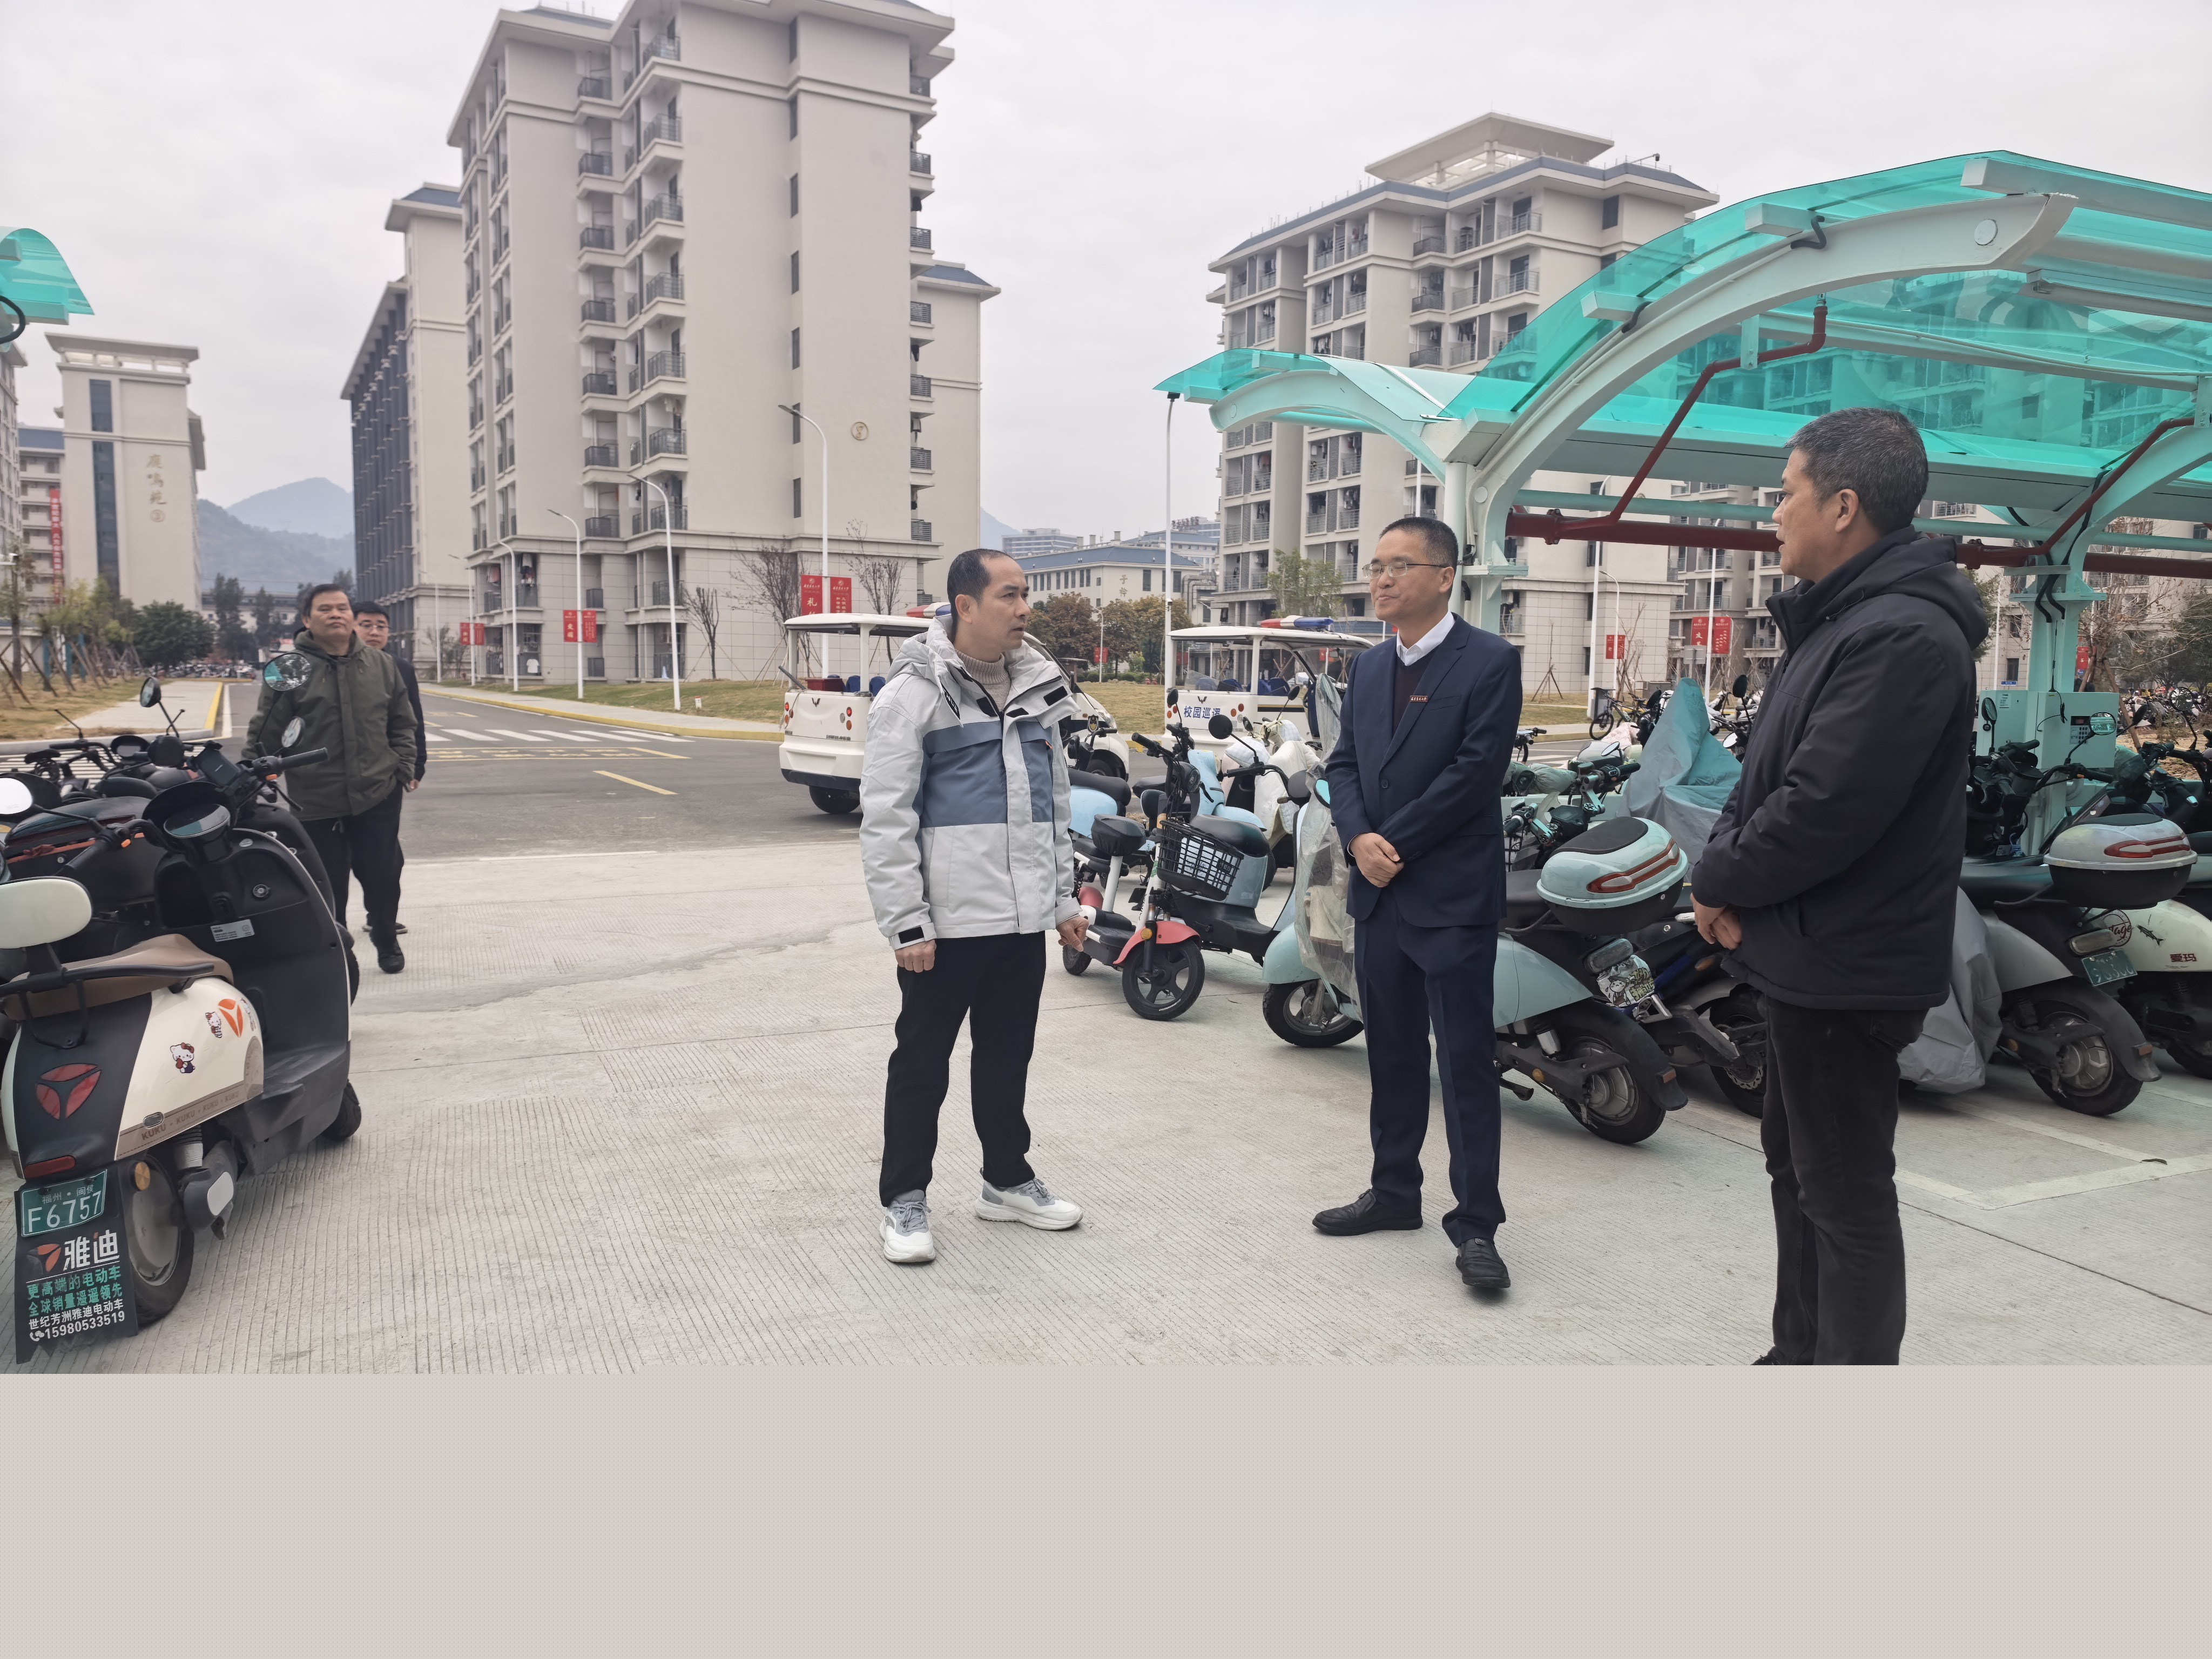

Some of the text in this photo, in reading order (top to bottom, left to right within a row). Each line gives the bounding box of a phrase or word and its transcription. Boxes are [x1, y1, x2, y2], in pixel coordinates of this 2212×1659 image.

[2170, 953, 2197, 962] 爱玛
[141, 1091, 239, 1141] KUKU KUKU KUKU KUKU
[28, 1190, 102, 1232] F6757
[63, 1229, 120, 1271] 雅迪
[26, 1265, 122, 1300] 更高端的电动车
[29, 1283, 123, 1317] 全球销量遥遥领先
[29, 1298, 124, 1330] 世纪芳洲雅迪电动车
[45, 1310, 125, 1339] 15980533519
